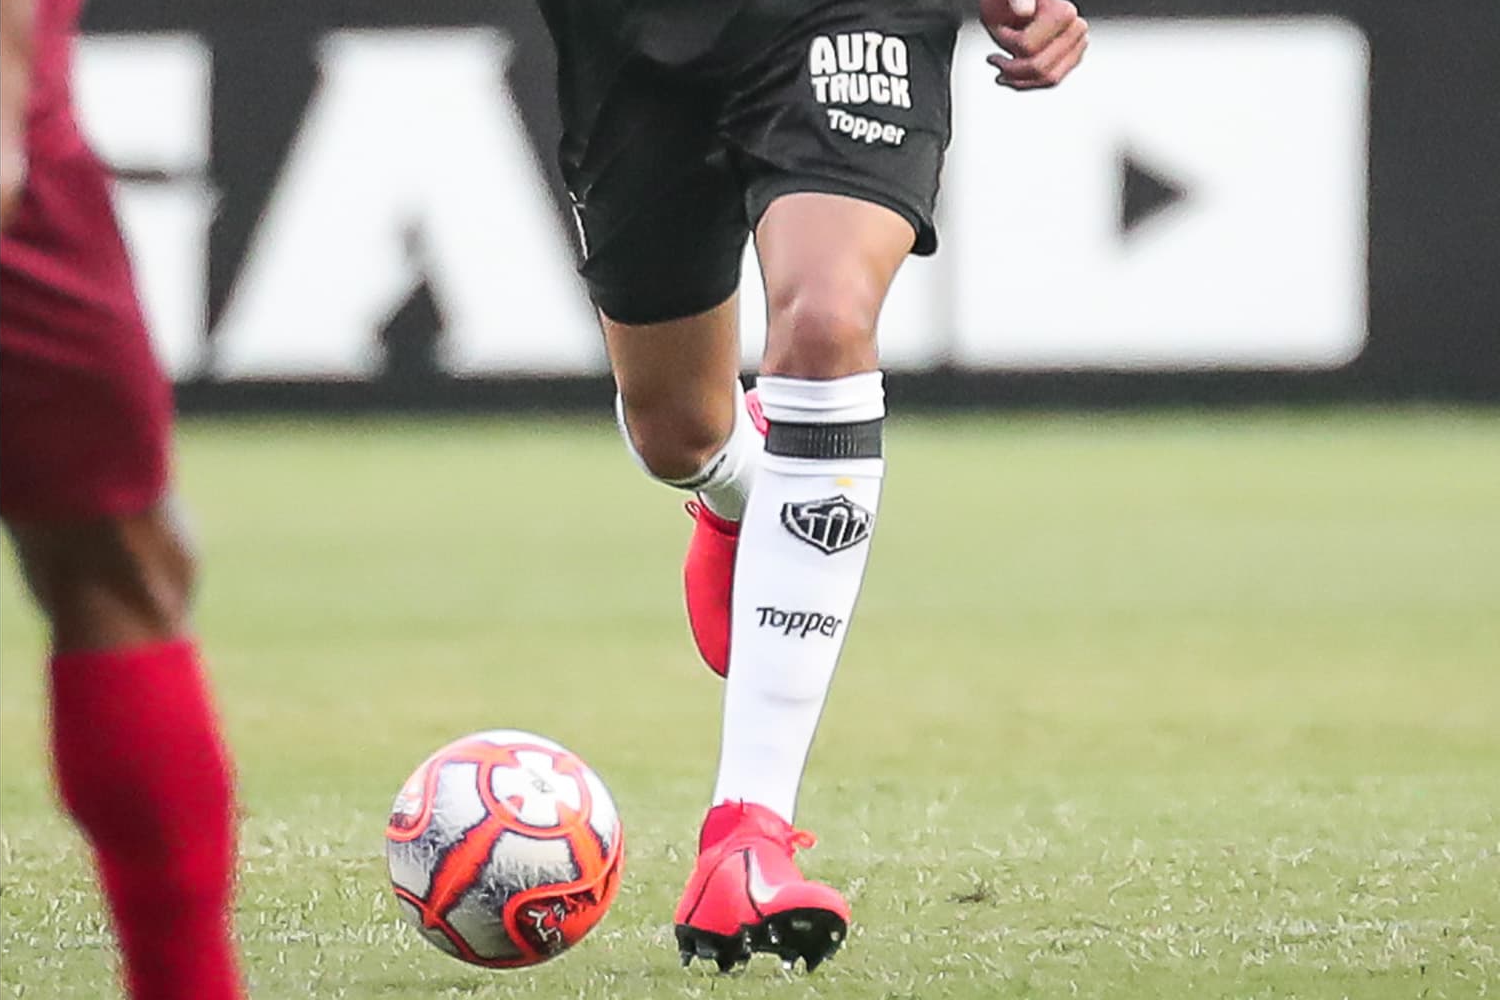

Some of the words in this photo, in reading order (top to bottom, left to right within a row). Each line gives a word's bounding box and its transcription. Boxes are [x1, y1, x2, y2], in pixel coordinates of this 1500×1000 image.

[809, 31, 908, 76] AUTO
[811, 72, 912, 109] TRUCK
[827, 108, 906, 146] Topper
[755, 606, 843, 638] Topper
